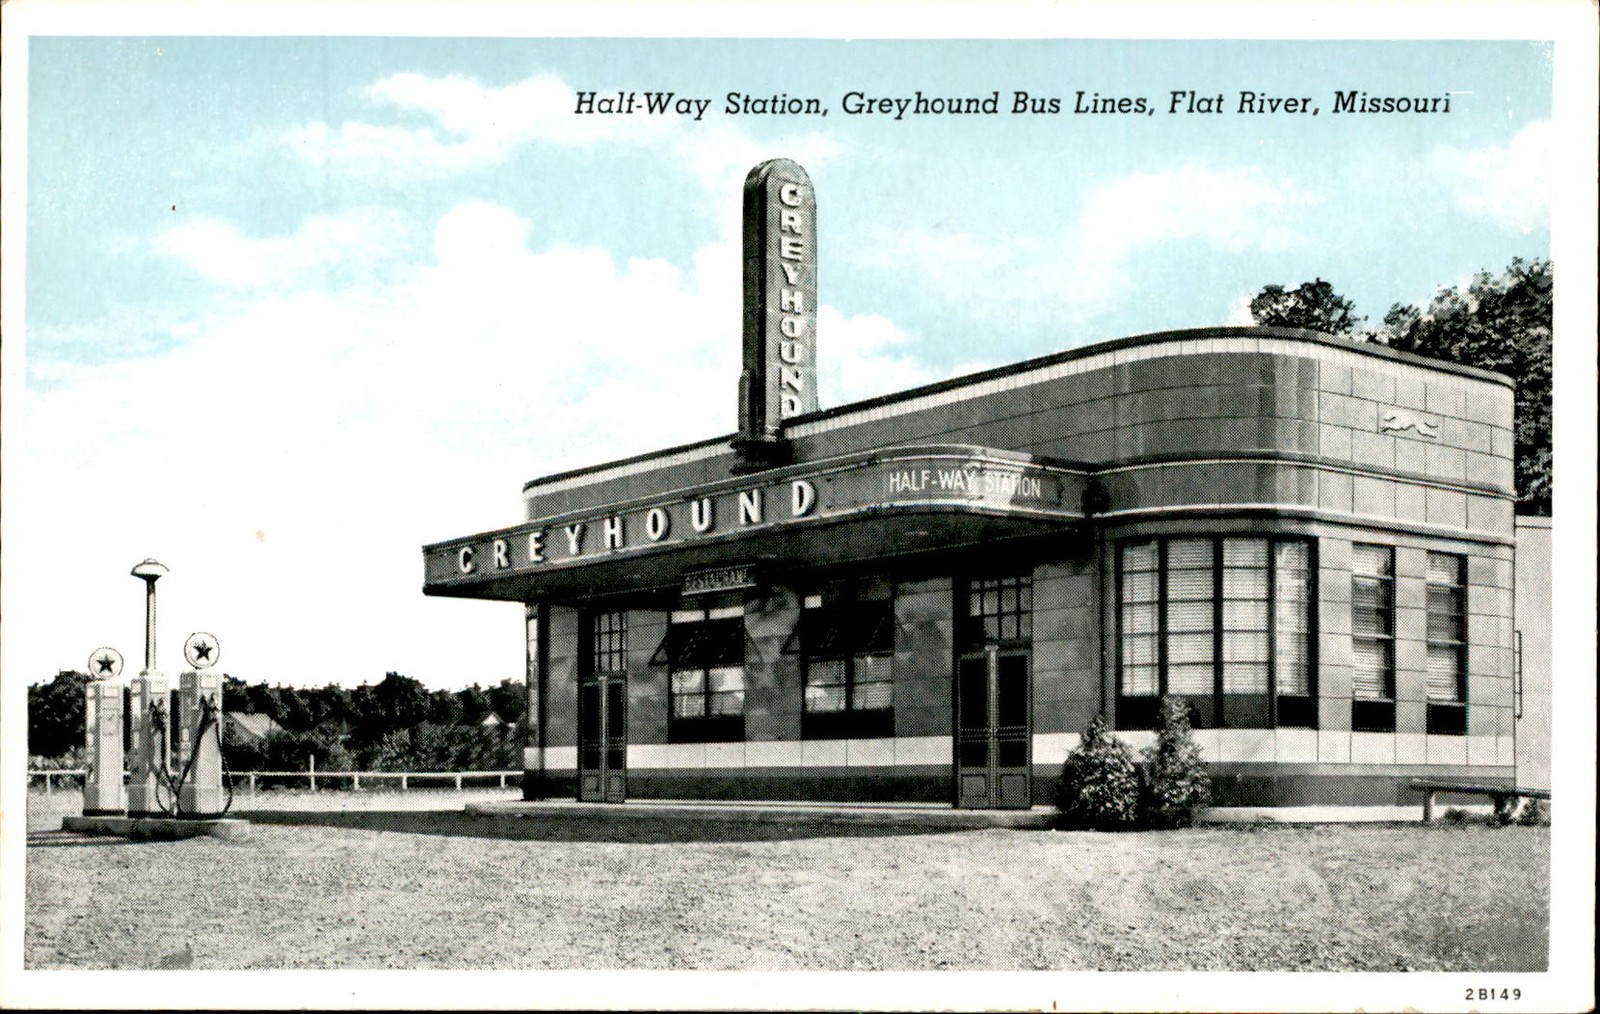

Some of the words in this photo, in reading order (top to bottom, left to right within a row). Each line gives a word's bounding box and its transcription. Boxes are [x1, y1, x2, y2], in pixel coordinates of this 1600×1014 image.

[780, 182, 802, 420] GREYHOUND
[889, 469, 976, 493] HALF-WAY
[984, 472, 1041, 498] STATION
